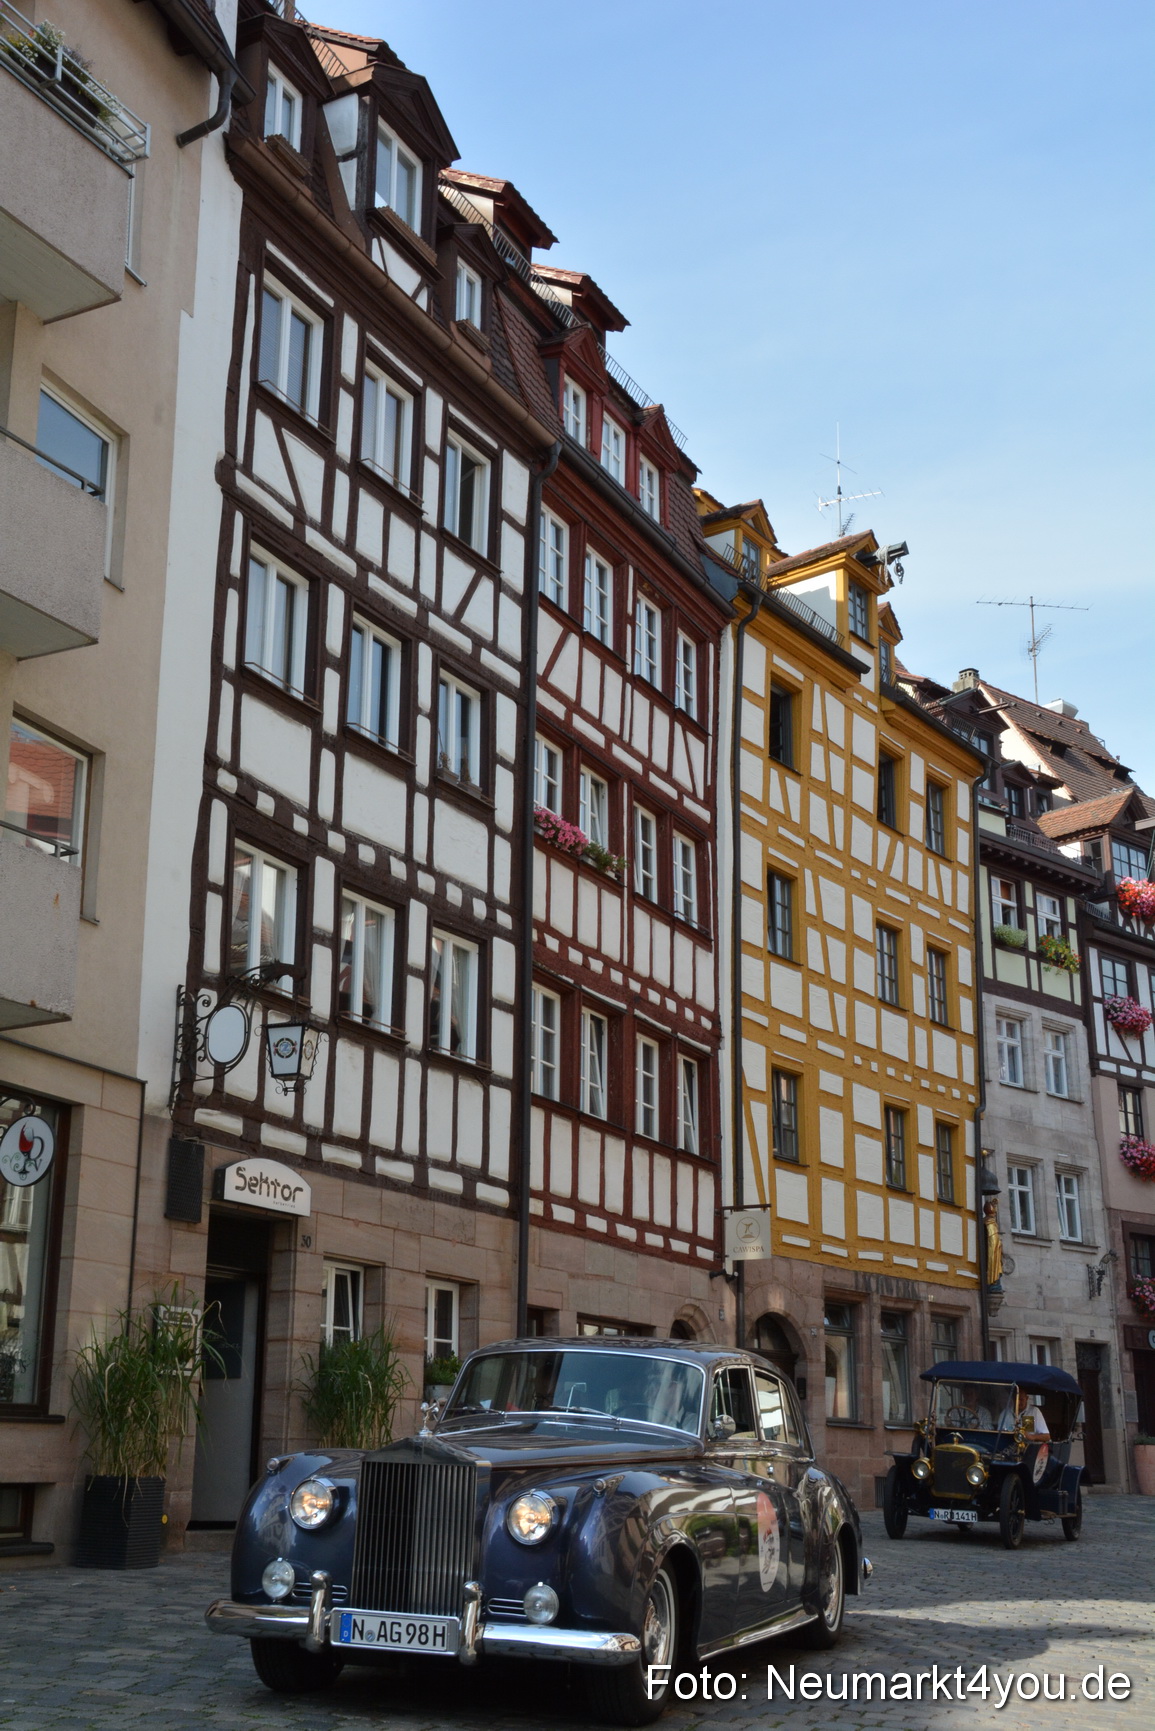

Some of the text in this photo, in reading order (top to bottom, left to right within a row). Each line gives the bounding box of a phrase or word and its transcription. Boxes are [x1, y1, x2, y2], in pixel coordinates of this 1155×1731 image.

[234, 1165, 304, 1203] Sektor
[301, 1234, 312, 1249] 30
[732, 1245, 765, 1254] CAWISPA
[352, 1618, 365, 1641] N
